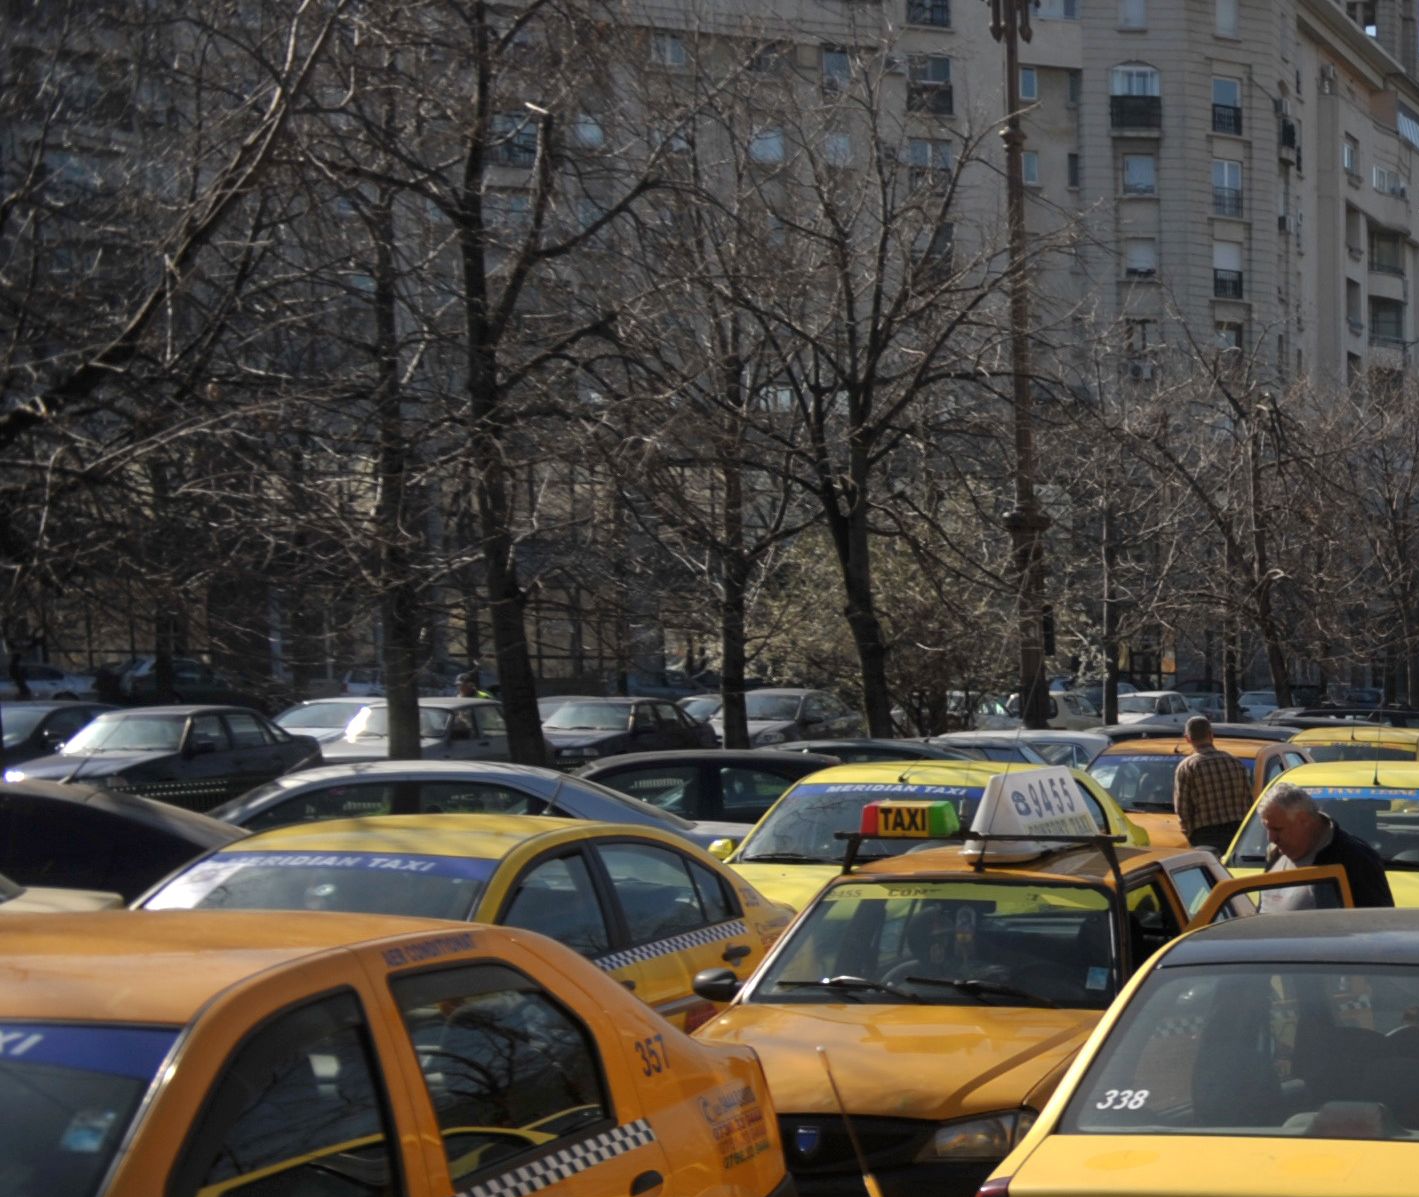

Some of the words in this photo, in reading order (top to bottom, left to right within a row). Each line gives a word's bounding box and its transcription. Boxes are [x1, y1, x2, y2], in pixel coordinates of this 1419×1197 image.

[826, 784, 917, 794] MERIDIAN
[922, 786, 968, 797] TAXI
[880, 808, 927, 832] TAXI
[367, 857, 438, 872] TAXI
[1096, 1089, 1150, 1110] 338
